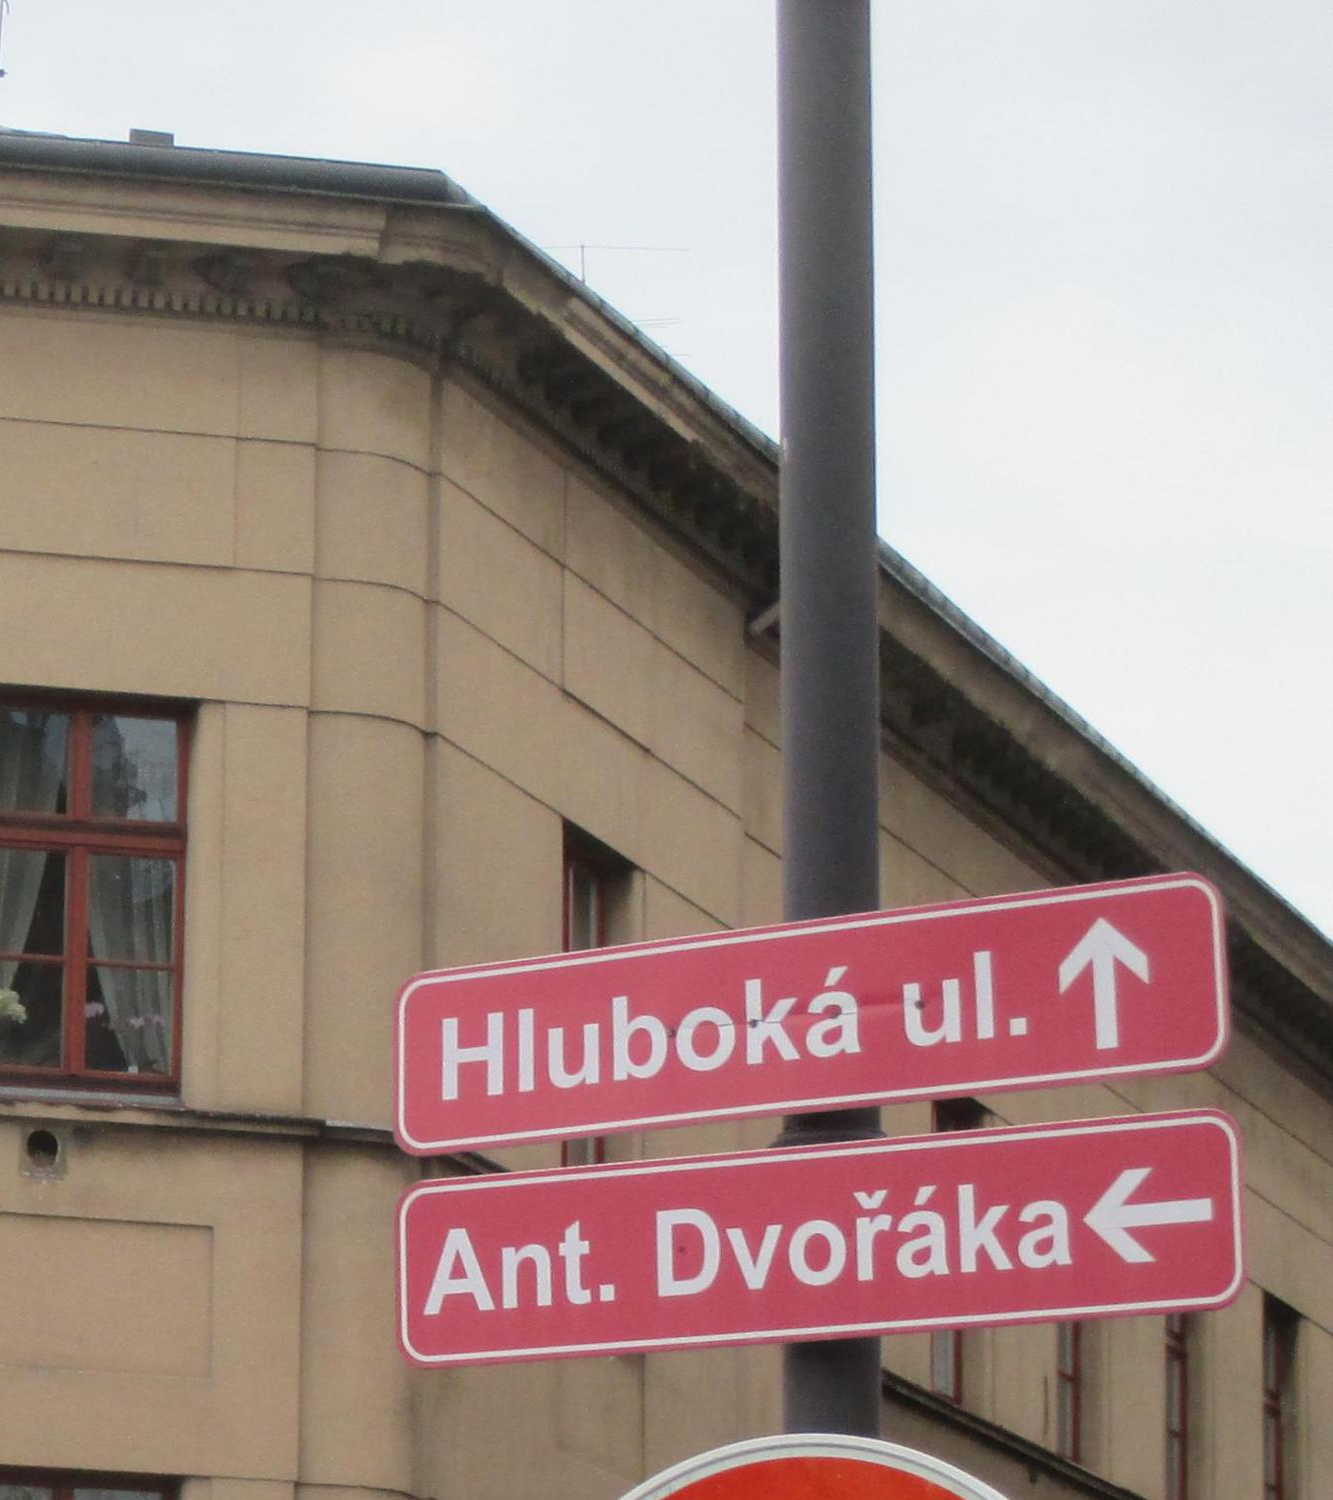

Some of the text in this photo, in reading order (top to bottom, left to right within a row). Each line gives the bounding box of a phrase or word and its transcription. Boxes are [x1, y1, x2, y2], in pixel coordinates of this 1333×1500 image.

[440, 949, 1029, 1102] Hluboká ul.
[422, 1183, 1073, 1318] Ant. Dvořáka
